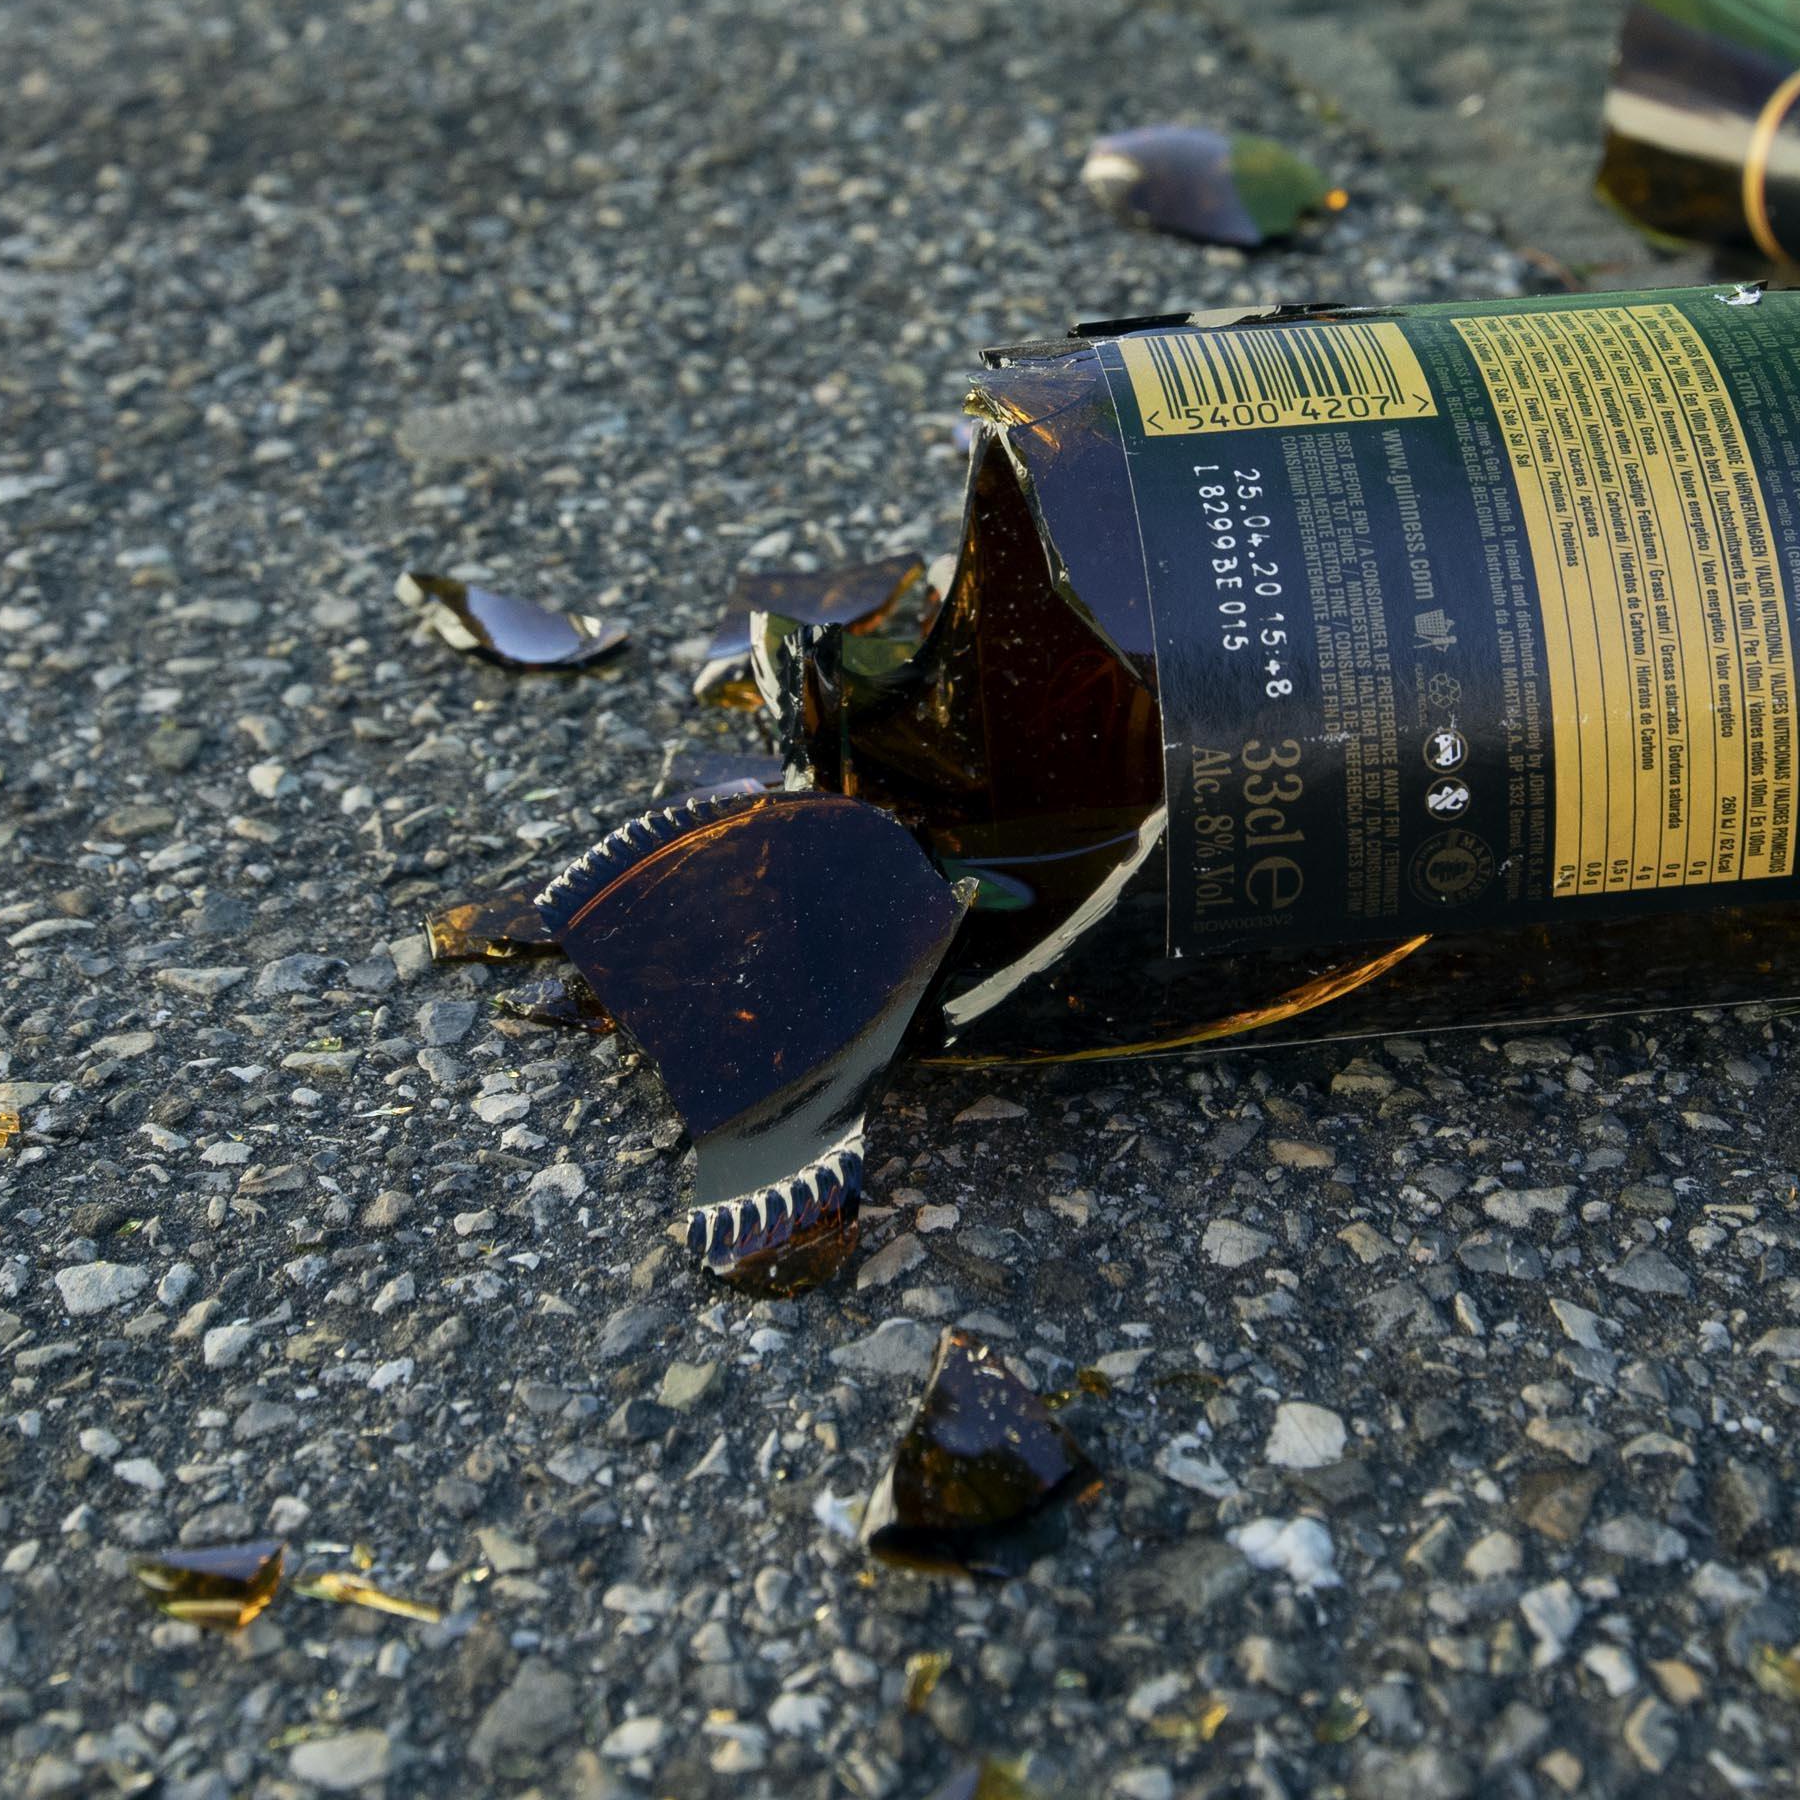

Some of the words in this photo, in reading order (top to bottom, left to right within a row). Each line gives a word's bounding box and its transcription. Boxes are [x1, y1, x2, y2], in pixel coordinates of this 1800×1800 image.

[1434, 366, 1457, 395] Genval,
[1493, 387, 1511, 403] Salz
[1542, 377, 1561, 401] Zucker
[1647, 377, 1669, 404] Energie
[1682, 391, 1699, 406] Een
[1184, 401, 1279, 430] 5400
[1301, 393, 1389, 422] 4207
[1501, 408, 1518, 426] Sale
[1553, 406, 1577, 441] Zuccheri
[1688, 407, 1710, 432] 100ml
[1333, 431, 1354, 459] BEST
[1508, 432, 1526, 446] Sal
[1534, 427, 1554, 463] Proteine
[1614, 428, 1631, 455] vetten
[1660, 410, 1686, 452] Brennwert
[1693, 433, 1717, 457] portie
[1708, 397, 1744, 465] VOEDINGSWAARDE
[1747, 410, 1775, 467] Ingredientes:
[1280, 435, 1307, 496] CONSUMIR
[1316, 432, 1343, 495] HOUDBAAR
[1484, 456, 1501, 484] Gate,
[1514, 453, 1532, 468] Sal
[1567, 447, 1587, 487] Azúcares
[1585, 423, 1613, 483] Kohlenhydrate
[1673, 453, 1689, 462] in
[1781, 440, 1799, 465] malta
[1299, 434, 1334, 539] PREFERIBILMENTE
[1340, 462, 1364, 507] BEFORE
[1623, 461, 1646, 507] Gesättigte
[1679, 469, 1697, 499] Valore
[1704, 459, 1725, 483] bevat
[1331, 499, 1350, 522] TOT
[1351, 509, 1370, 535] END
[1382, 427, 1433, 601] www.guinness.com
[1491, 487, 1512, 522] Dublin
[1576, 494, 1599, 538] açúcares
[1605, 490, 1630, 543] Carboidrati
[1733, 470, 1767, 558] NÄHRWERTANGABEN
[1775, 498, 1792, 526] malte
[1336, 526, 1357, 565] EINDE
[1499, 524, 1516, 536] 8,
[1637, 508, 1657, 560] Fettsäuren
[1714, 489, 1746, 580] Durchschnittswerte
[1783, 527, 1798, 543] de
[1193, 463, 1219, 477] L
[1218, 599, 1248, 652] 015
[1295, 498, 1329, 621] PREFERENTEMENTE
[1320, 541, 1342, 584] ENTRO
[1358, 547, 1374, 557] A
[1503, 539, 1524, 580] Ireland
[1234, 467, 1281, 598] 25.04.20
[1260, 611, 1292, 699] 15:48
[1484, 543, 1506, 606] Distribuito
[1619, 551, 1637, 593] Hidratos
[1649, 568, 1668, 602] Grassi
[1701, 560, 1717, 586] Valor
[1734, 581, 1751, 597] für
[1755, 564, 1775, 598] VALORI
[1328, 587, 1347, 618] FINE
[1361, 560, 1387, 649] CONSOMMER
[1511, 583, 1528, 606] and
[1626, 596, 1642, 609] de
[1346, 580, 1371, 669] MINDESTENS
[1494, 608, 1510, 624] da
[1654, 603, 1672, 634] saturi
[1706, 588, 1726, 644] energético
[1737, 598, 1757, 630] 100ml
[1761, 599, 1784, 665] NUTRIZIONALI
[1315, 623, 1334, 668] ANTES
[1497, 627, 1515, 663] JOHN
[1515, 609, 1537, 677] distributed
[1629, 611, 1646, 656] Carbono
[1639, 426, 1658, 456] Grasas
[1691, 859, 1707, 868] 0
[1743, 639, 1760, 658] Per
[1334, 631, 1357, 706] CONSUMIR
[1373, 652, 1391, 672] DE
[1660, 642, 1675, 681] Grasas
[1715, 652, 1731, 680] Valor
[1745, 659, 1764, 692] 100ml
[1320, 673, 1337, 691] DE
[1502, 666, 1521, 719] MARTIN
[1636, 664, 1652, 709] Hidratos
[1322, 694, 1339, 718] FIN
[1342, 710, 1359, 728] DE
[1358, 674, 1377, 738] HALTBAR
[1377, 675, 1397, 764] PREFERENCE
[1523, 680, 1542, 750] exclusively
[1639, 711, 1654, 725] de
[1664, 683, 1681, 735] saturadas
[1717, 682, 1735, 738] energético
[1749, 701, 1765, 739] Valores
[1363, 742, 1379, 766] BIS
[1508, 754, 1523, 772] BP
[1525, 753, 1543, 769] by
[1640, 727, 1656, 771] Carbono
[1668, 744, 1684, 785] Gordura
[1750, 740, 1767, 776] médios
[1773, 716, 1790, 780] NUTRICIONAIS
[1191, 741, 1231, 803] Alc.
[1343, 732, 1362, 824] PREFERENCIA
[1364, 771, 1380, 799] END
[1383, 767, 1399, 813] AVANT
[1509, 774, 1524, 805] 1332
[1528, 771, 1544, 805] JOHN
[1242, 735, 1303, 848] 33cl
[1668, 787, 1683, 829] saturada
[1721, 795, 1736, 815] 260
[1750, 777, 1767, 808] 100ml
[1772, 787, 1790, 825] VALORES
[1194, 812, 1234, 858] 8%
[1366, 815, 1381, 834] DA
[1384, 816, 1399, 837] FIN
[1529, 808, 1544, 855] MARTIN
[1750, 814, 1767, 826] En
[1347, 827, 1363, 867] ANTES
[1719, 837, 1735, 851] 62
[1747, 828, 1765, 856] 100ml
[1769, 826, 1788, 873] PROMEDIOS
[1639, 864, 1654, 872] 4
[1665, 862, 1681, 870] 0
[1717, 852, 1734, 873] Kcal
[1194, 863, 1234, 915] Vol.
